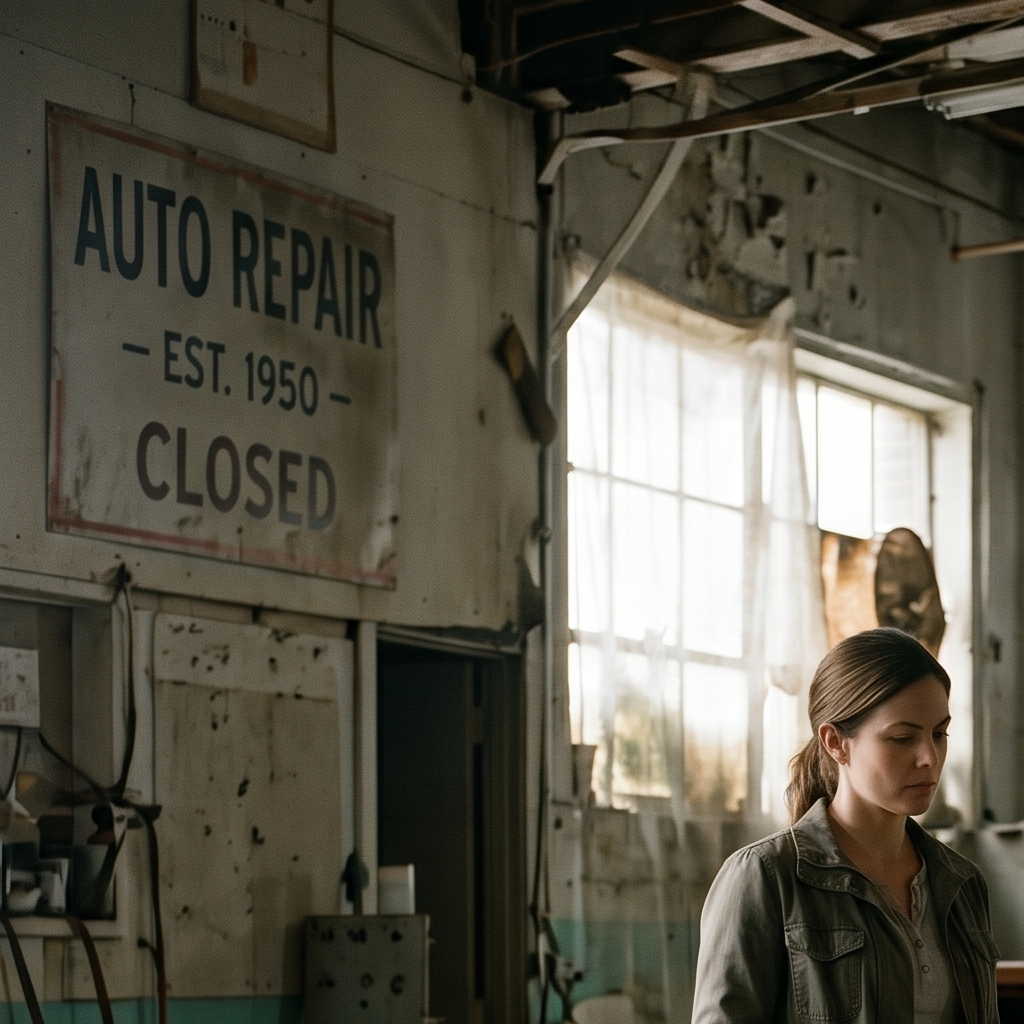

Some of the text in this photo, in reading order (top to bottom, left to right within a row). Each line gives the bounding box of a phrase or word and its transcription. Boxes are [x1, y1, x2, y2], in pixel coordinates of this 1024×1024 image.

[74, 165, 383, 349] AUTO REPAIR
[164, 330, 319, 416] EST. 1950
[136, 421, 336, 531] CLOSED
